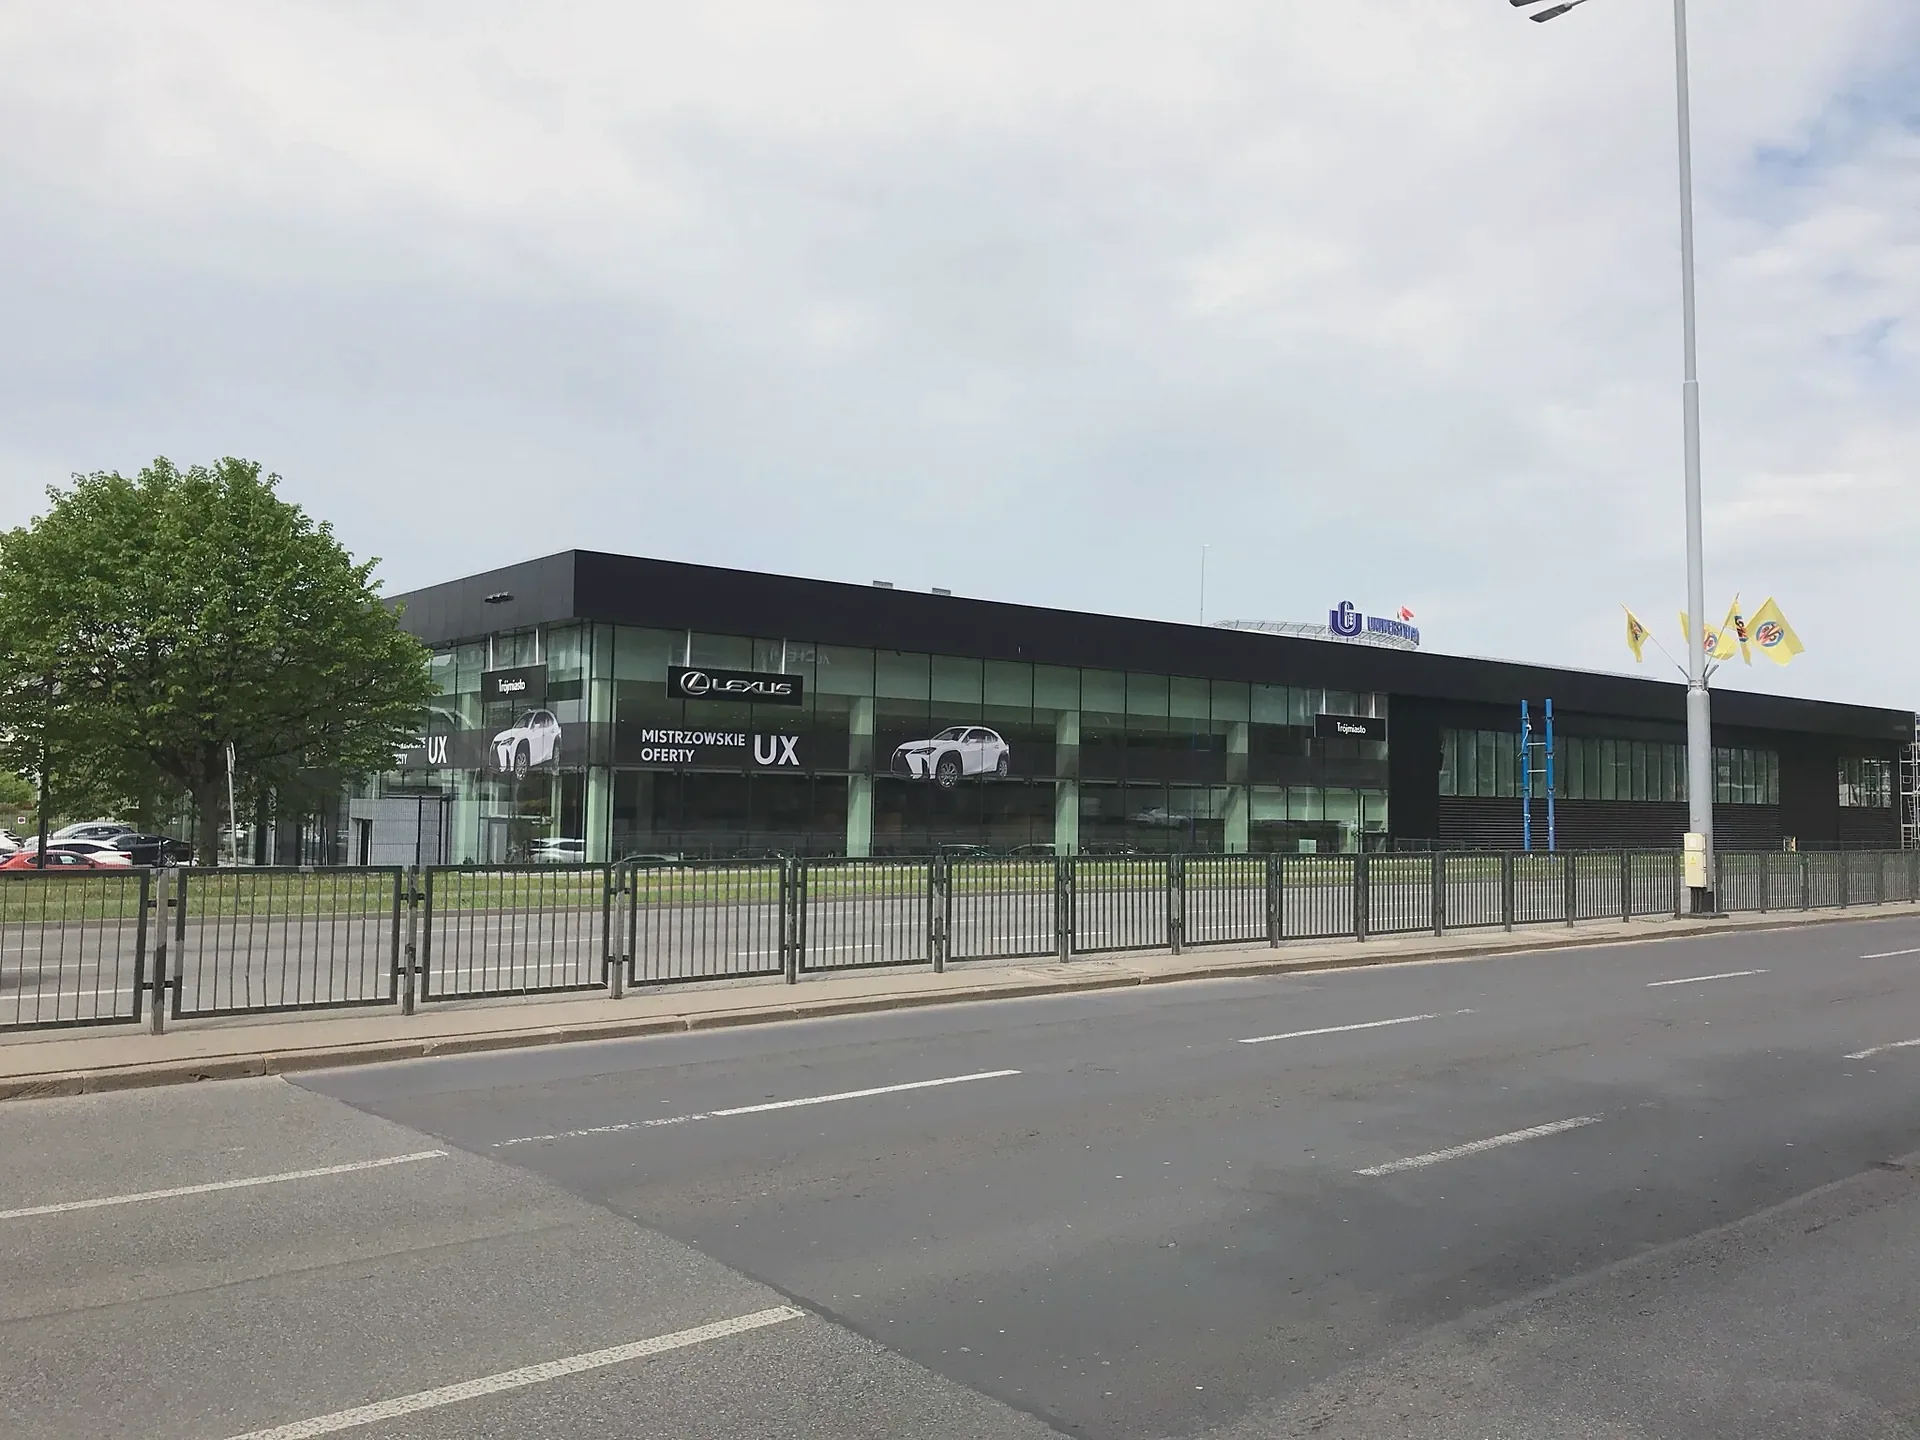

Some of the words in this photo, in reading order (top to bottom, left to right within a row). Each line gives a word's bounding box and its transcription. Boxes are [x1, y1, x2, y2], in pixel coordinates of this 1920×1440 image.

[712, 678, 792, 695] LEXUS
[641, 729, 746, 746] MISTRZOWSKIE
[428, 735, 448, 764] UX
[640, 748, 695, 763] OFERTY
[754, 734, 800, 765] UX
